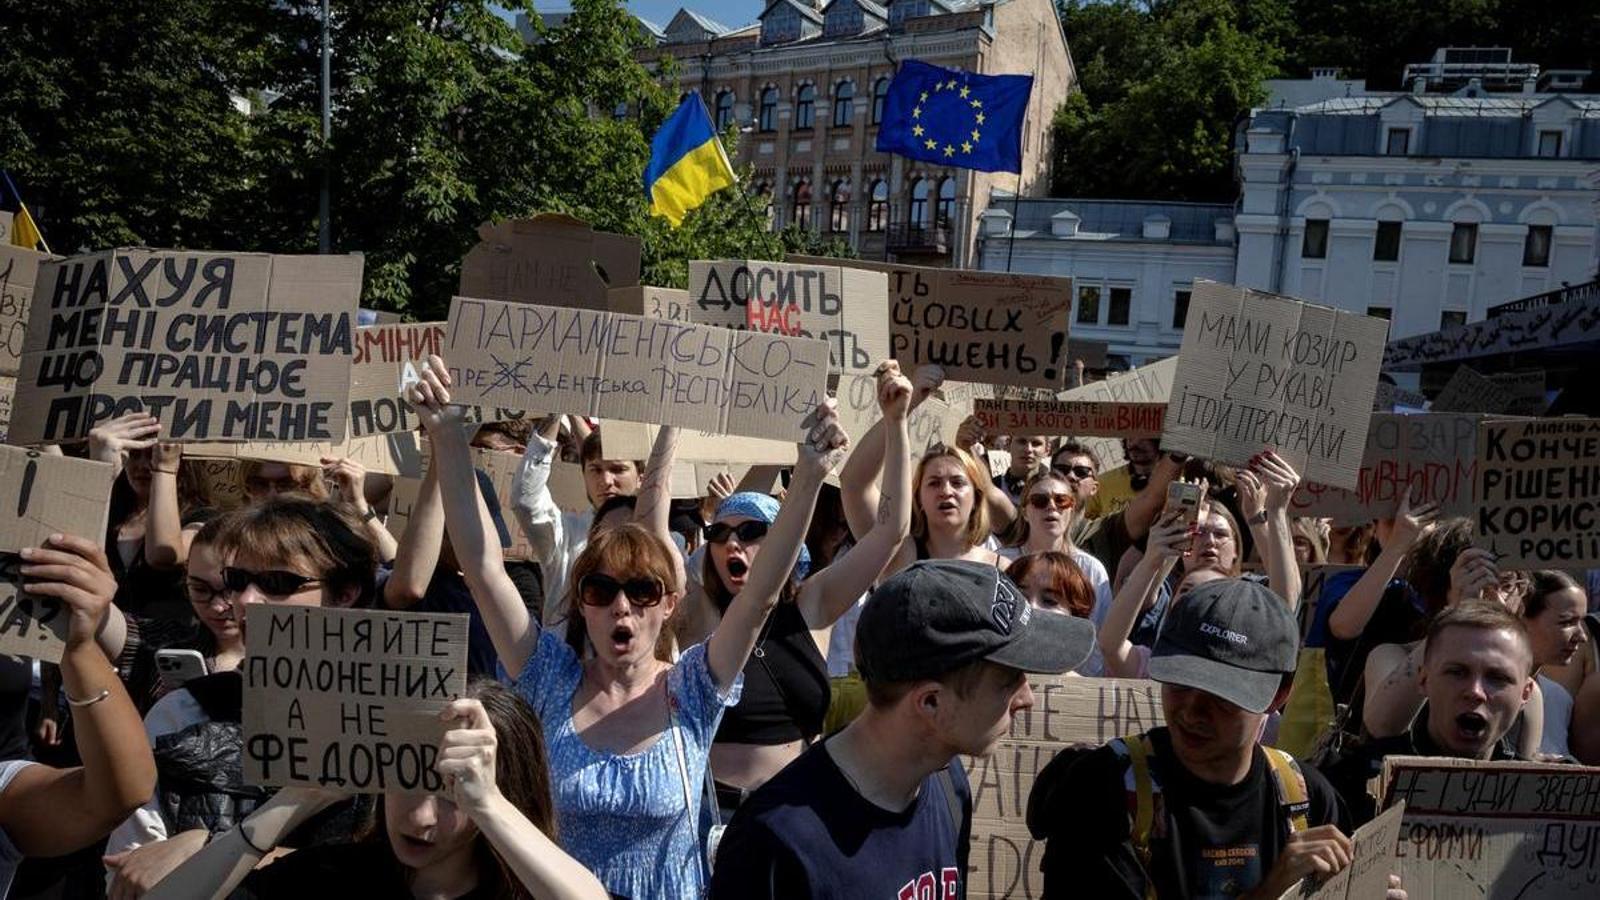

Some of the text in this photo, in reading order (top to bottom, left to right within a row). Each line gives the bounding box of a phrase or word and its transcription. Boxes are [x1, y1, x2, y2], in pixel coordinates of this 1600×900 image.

[51, 256, 235, 308] НАХУЯ
[697, 266, 841, 316] ДОСИТЬ
[46, 307, 352, 355] МЕНІ СИСТЕМА
[747, 298, 801, 336] НАС
[451, 300, 815, 378] ПАРЛАМЕНТСЬКО-
[1200, 311, 1269, 357] МАЛИ
[1283, 330, 1357, 374] КОЗИР
[37, 351, 307, 397] ЩО ПРАЦЮЄ
[652, 365, 819, 415] РЕСПУБЛІКА
[1225, 359, 1248, 400] У
[1256, 363, 1337, 416] РУКАВІ,
[222, 400, 333, 439] МЕНЕ
[976, 399, 1009, 412] ПАНЕ
[1008, 414, 1028, 428] ЗА
[1035, 414, 1073, 428] КОГО
[1235, 404, 1346, 463] ПРОСРАЛИ
[1486, 428, 1598, 462] КОНЧЕ
[1483, 465, 1600, 500] РІШЕН
[1479, 503, 1600, 536] КОРИС
[268, 609, 452, 656] МІНЯЙТЕ
[1199, 622, 1248, 644] EXPLORER
[250, 656, 458, 700] ПОЛОНЕНИХ,
[288, 698, 387, 736] А НЕ
[1533, 776, 1600, 813] ЗВЕРН
[1396, 822, 1485, 861] ЕФОРМИ
